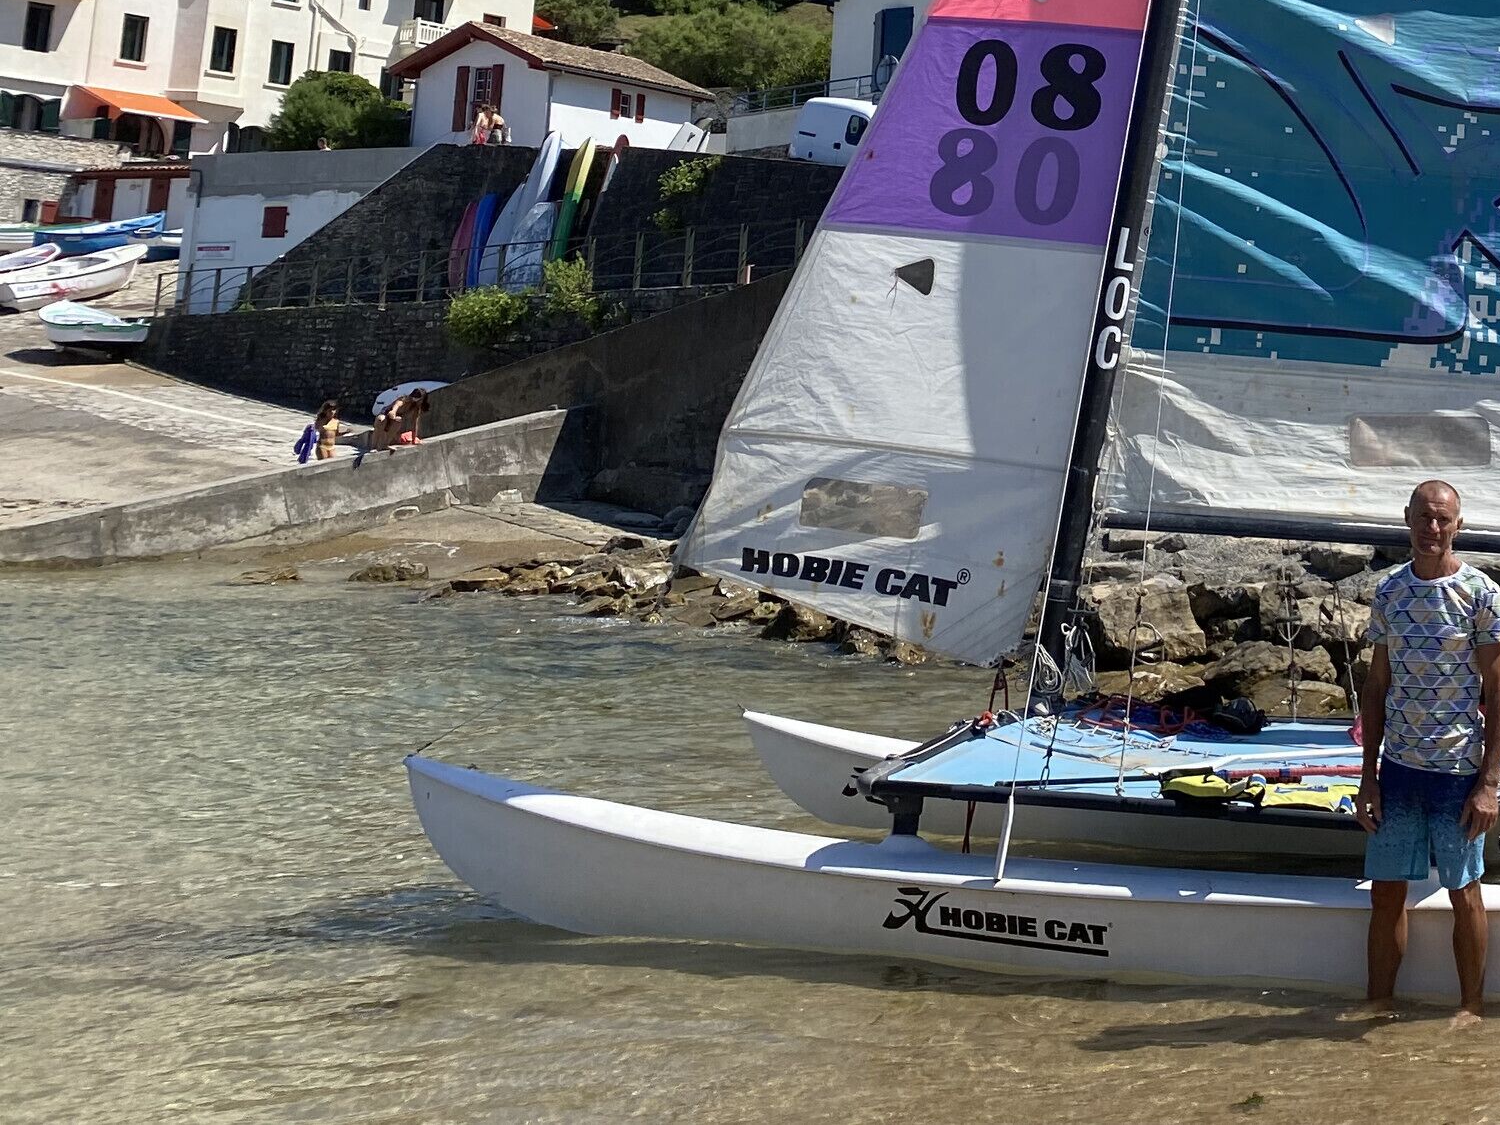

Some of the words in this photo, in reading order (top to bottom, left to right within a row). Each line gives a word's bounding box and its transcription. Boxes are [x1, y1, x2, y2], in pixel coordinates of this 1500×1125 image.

[956, 39, 1107, 131] 08
[1095, 227, 1134, 370] LOC
[740, 547, 870, 590] HOBIE
[939, 905, 1038, 938] HOBIE
[1044, 919, 1108, 946] CAT
